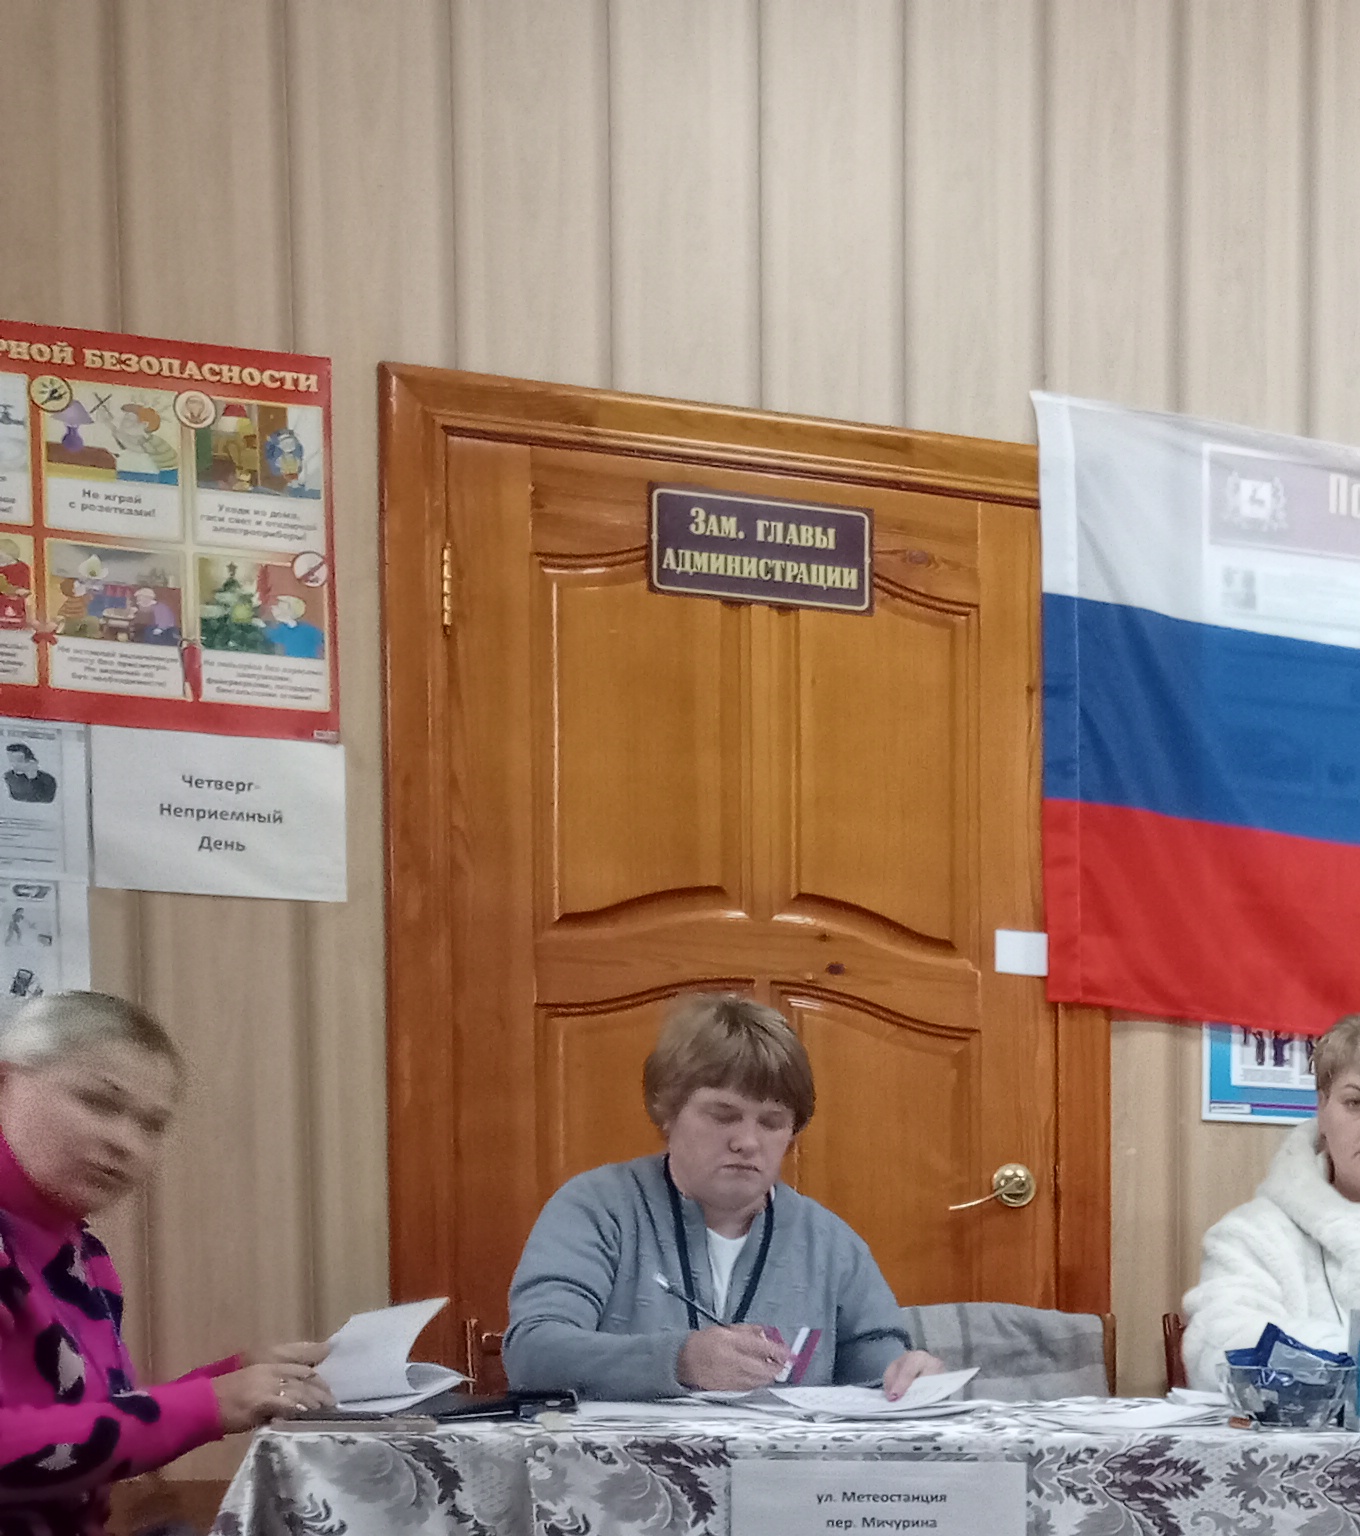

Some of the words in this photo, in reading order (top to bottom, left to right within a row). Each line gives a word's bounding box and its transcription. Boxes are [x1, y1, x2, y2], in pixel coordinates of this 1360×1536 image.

[83, 348, 320, 392] БЕЗОПАСНОСТИ
[756, 519, 836, 550] ГЛАВЫ
[662, 548, 859, 590] АДМИНИСТРАЦИИ
[159, 803, 283, 825] Неприемный
[198, 835, 246, 852] День
[817, 1492, 837, 1504] ул.
[842, 1491, 947, 1504] Метеостанция
[826, 1518, 856, 1530] пер.
[862, 1516, 937, 1530] Мичурина
